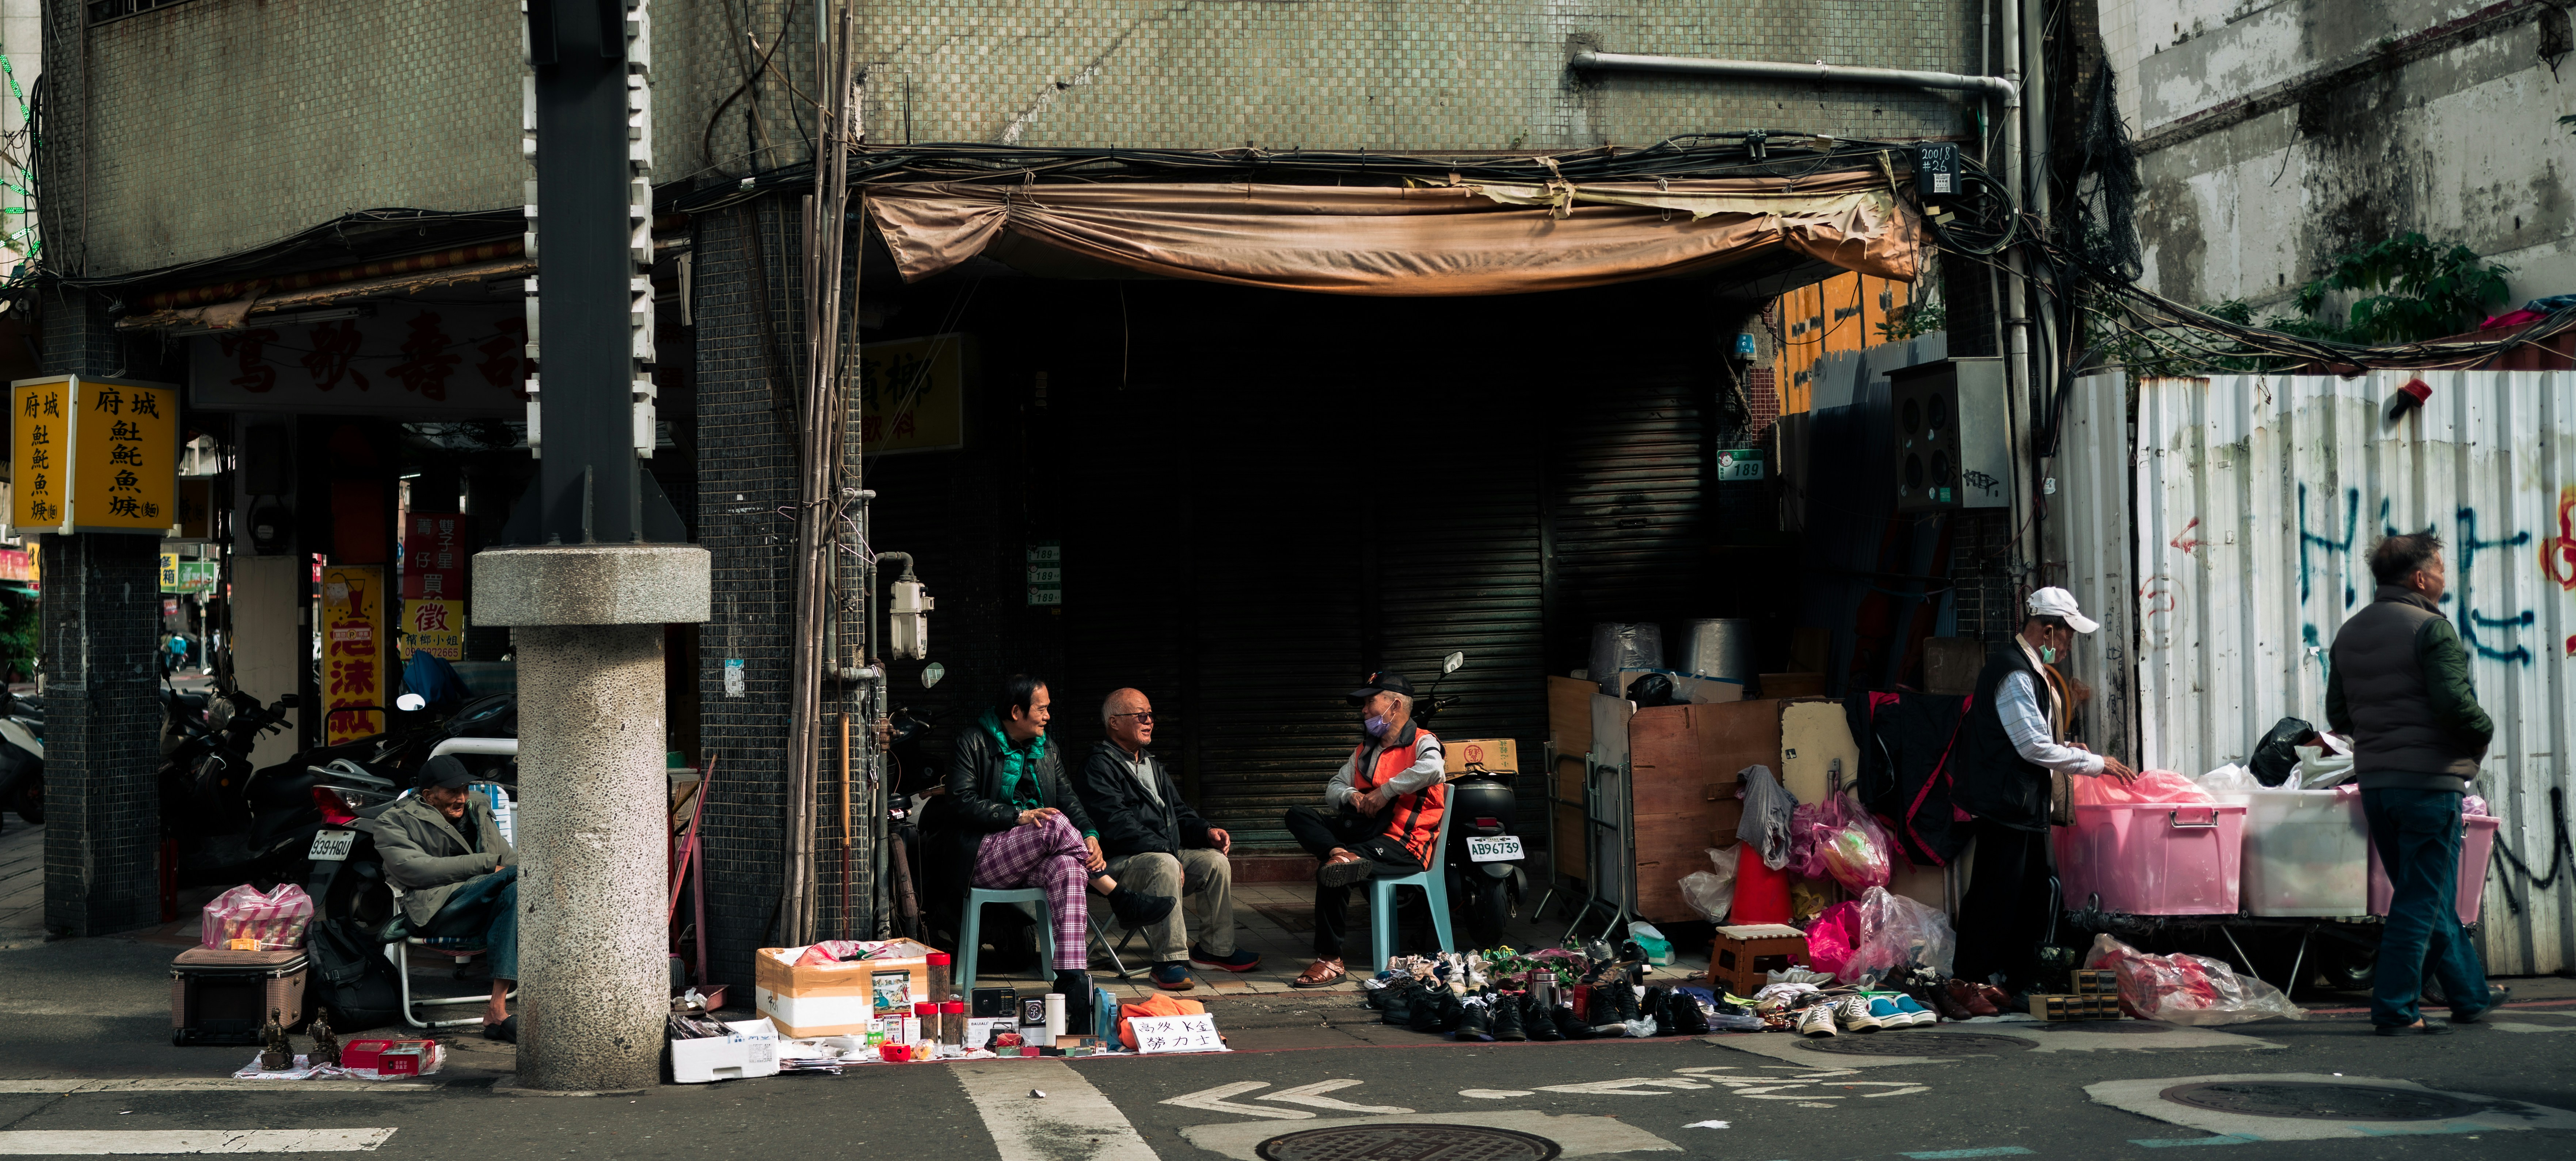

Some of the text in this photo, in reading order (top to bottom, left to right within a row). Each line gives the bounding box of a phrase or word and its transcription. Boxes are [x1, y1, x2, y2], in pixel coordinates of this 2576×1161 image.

[1922, 147, 1950, 160] 20018
[1922, 160, 1947, 172] #26
[24, 392, 59, 418] 府城
[94, 387, 159, 419] 府城
[861, 410, 916, 443] 飲料
[1735, 463, 1759, 476] 189
[415, 518, 433, 569] 菁仔
[438, 519, 455, 569] 雙子星
[1036, 550, 1053, 559] 189
[163, 569, 175, 584] 箱
[1036, 572, 1053, 580] 189
[422, 574, 443, 594] 買
[1037, 593, 1053, 602] 189
[414, 602, 450, 633] 徵
[406, 634, 459, 646] 檳榔小姐
[330, 621, 376, 746] 泡沫紅
[1499, 740, 1508, 767] 小心輕放
[1472, 842, 1519, 855] AB96739
[1147, 1035, 1210, 1050] 勞力士
